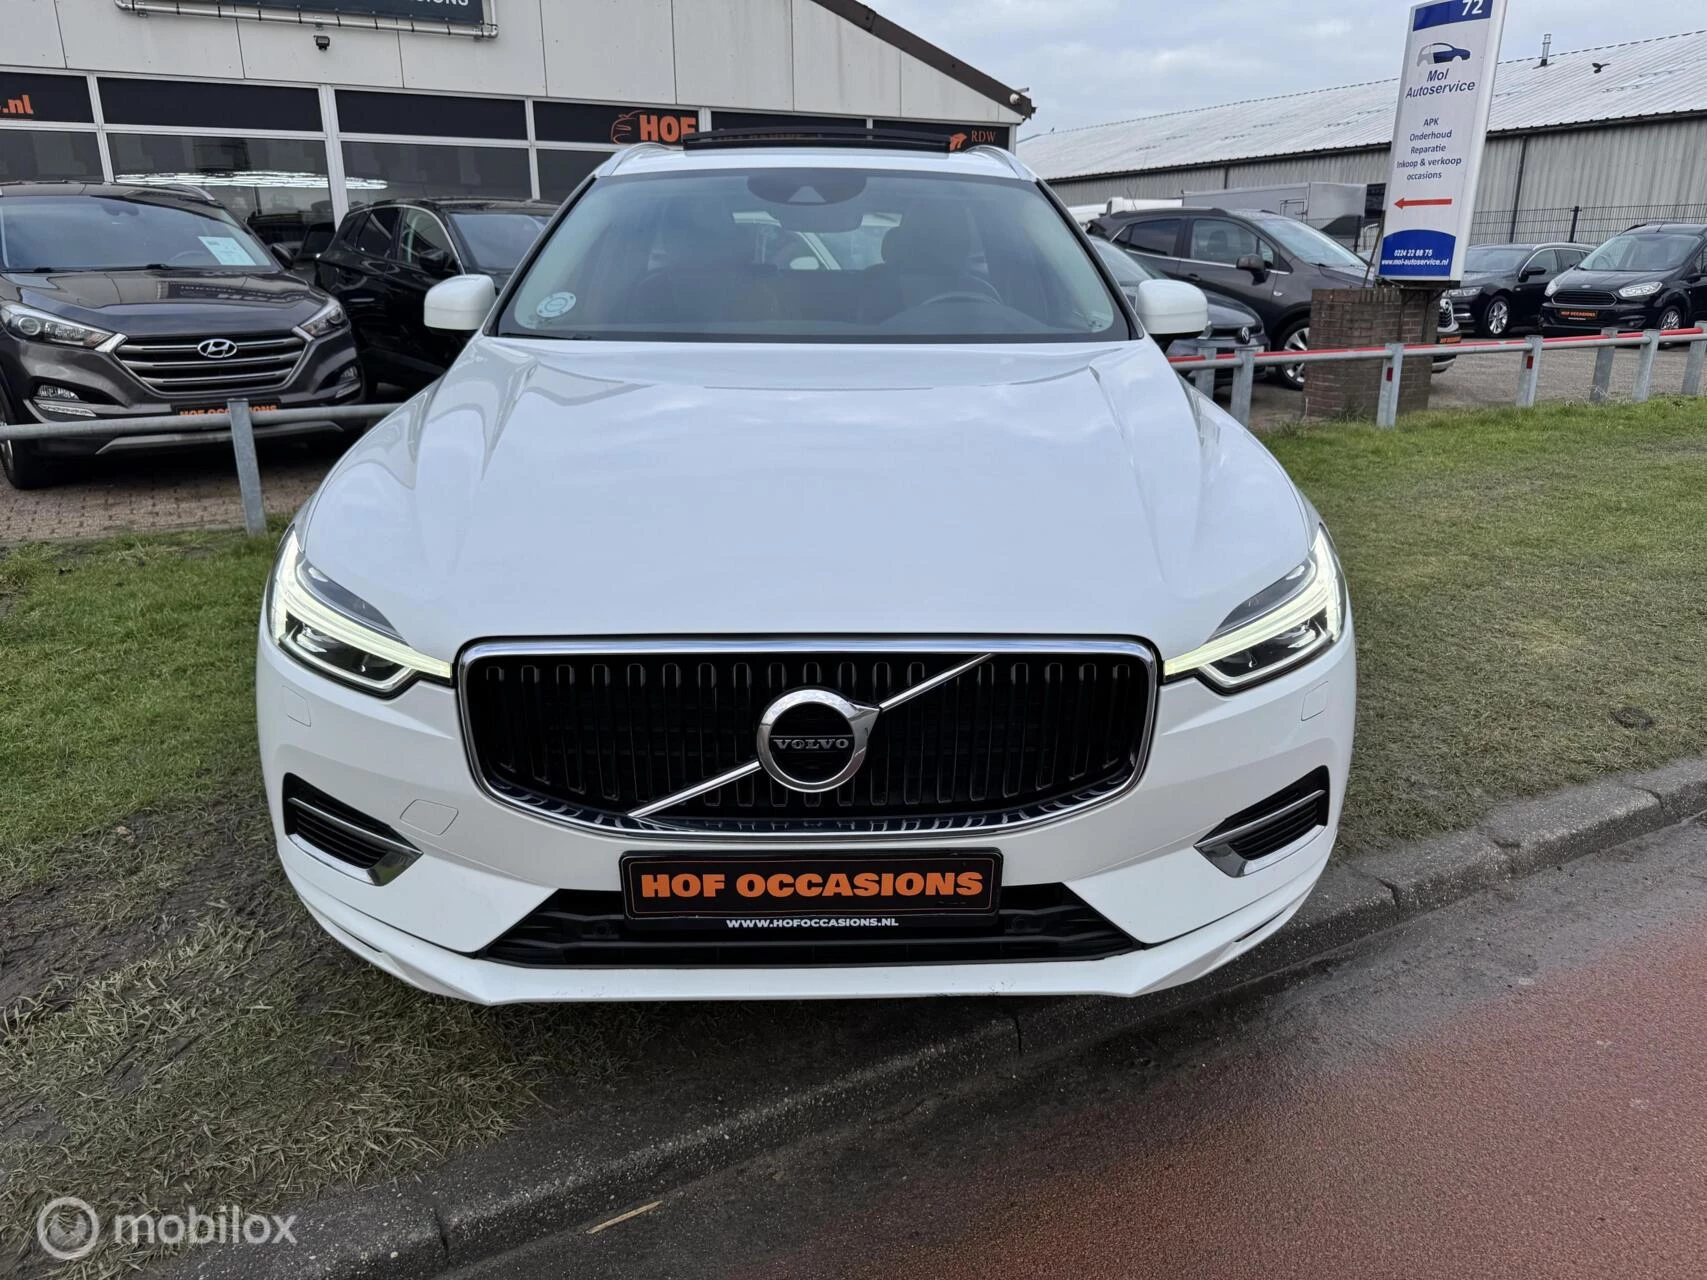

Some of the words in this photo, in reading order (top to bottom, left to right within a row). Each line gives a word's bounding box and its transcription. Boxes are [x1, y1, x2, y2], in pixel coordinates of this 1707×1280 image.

[1461, 0, 1483, 16] 72
[1427, 68, 1450, 82] Mol
[1405, 80, 1476, 98] Autoservice
[0, 94, 33, 114] .nl
[639, 114, 696, 142] HOF
[1423, 117, 1440, 127] APK
[971, 130, 996, 143] RDW
[1409, 129, 1452, 142] Onderhoud
[1410, 144, 1446, 155] Reparatie
[1396, 159, 1418, 169] Inkoop
[1419, 159, 1426, 167] &
[1427, 156, 1462, 167] verkoop
[1407, 171, 1442, 181] occasions
[1381, 258, 1449, 266] www.mol-autoservice.nl
[773, 739, 849, 750] VOLVO
[641, 873, 725, 898] HOF
[735, 871, 983, 898] OCCASIONS
[726, 918, 899, 929] WWW.HOFOCCASIONS.NL
